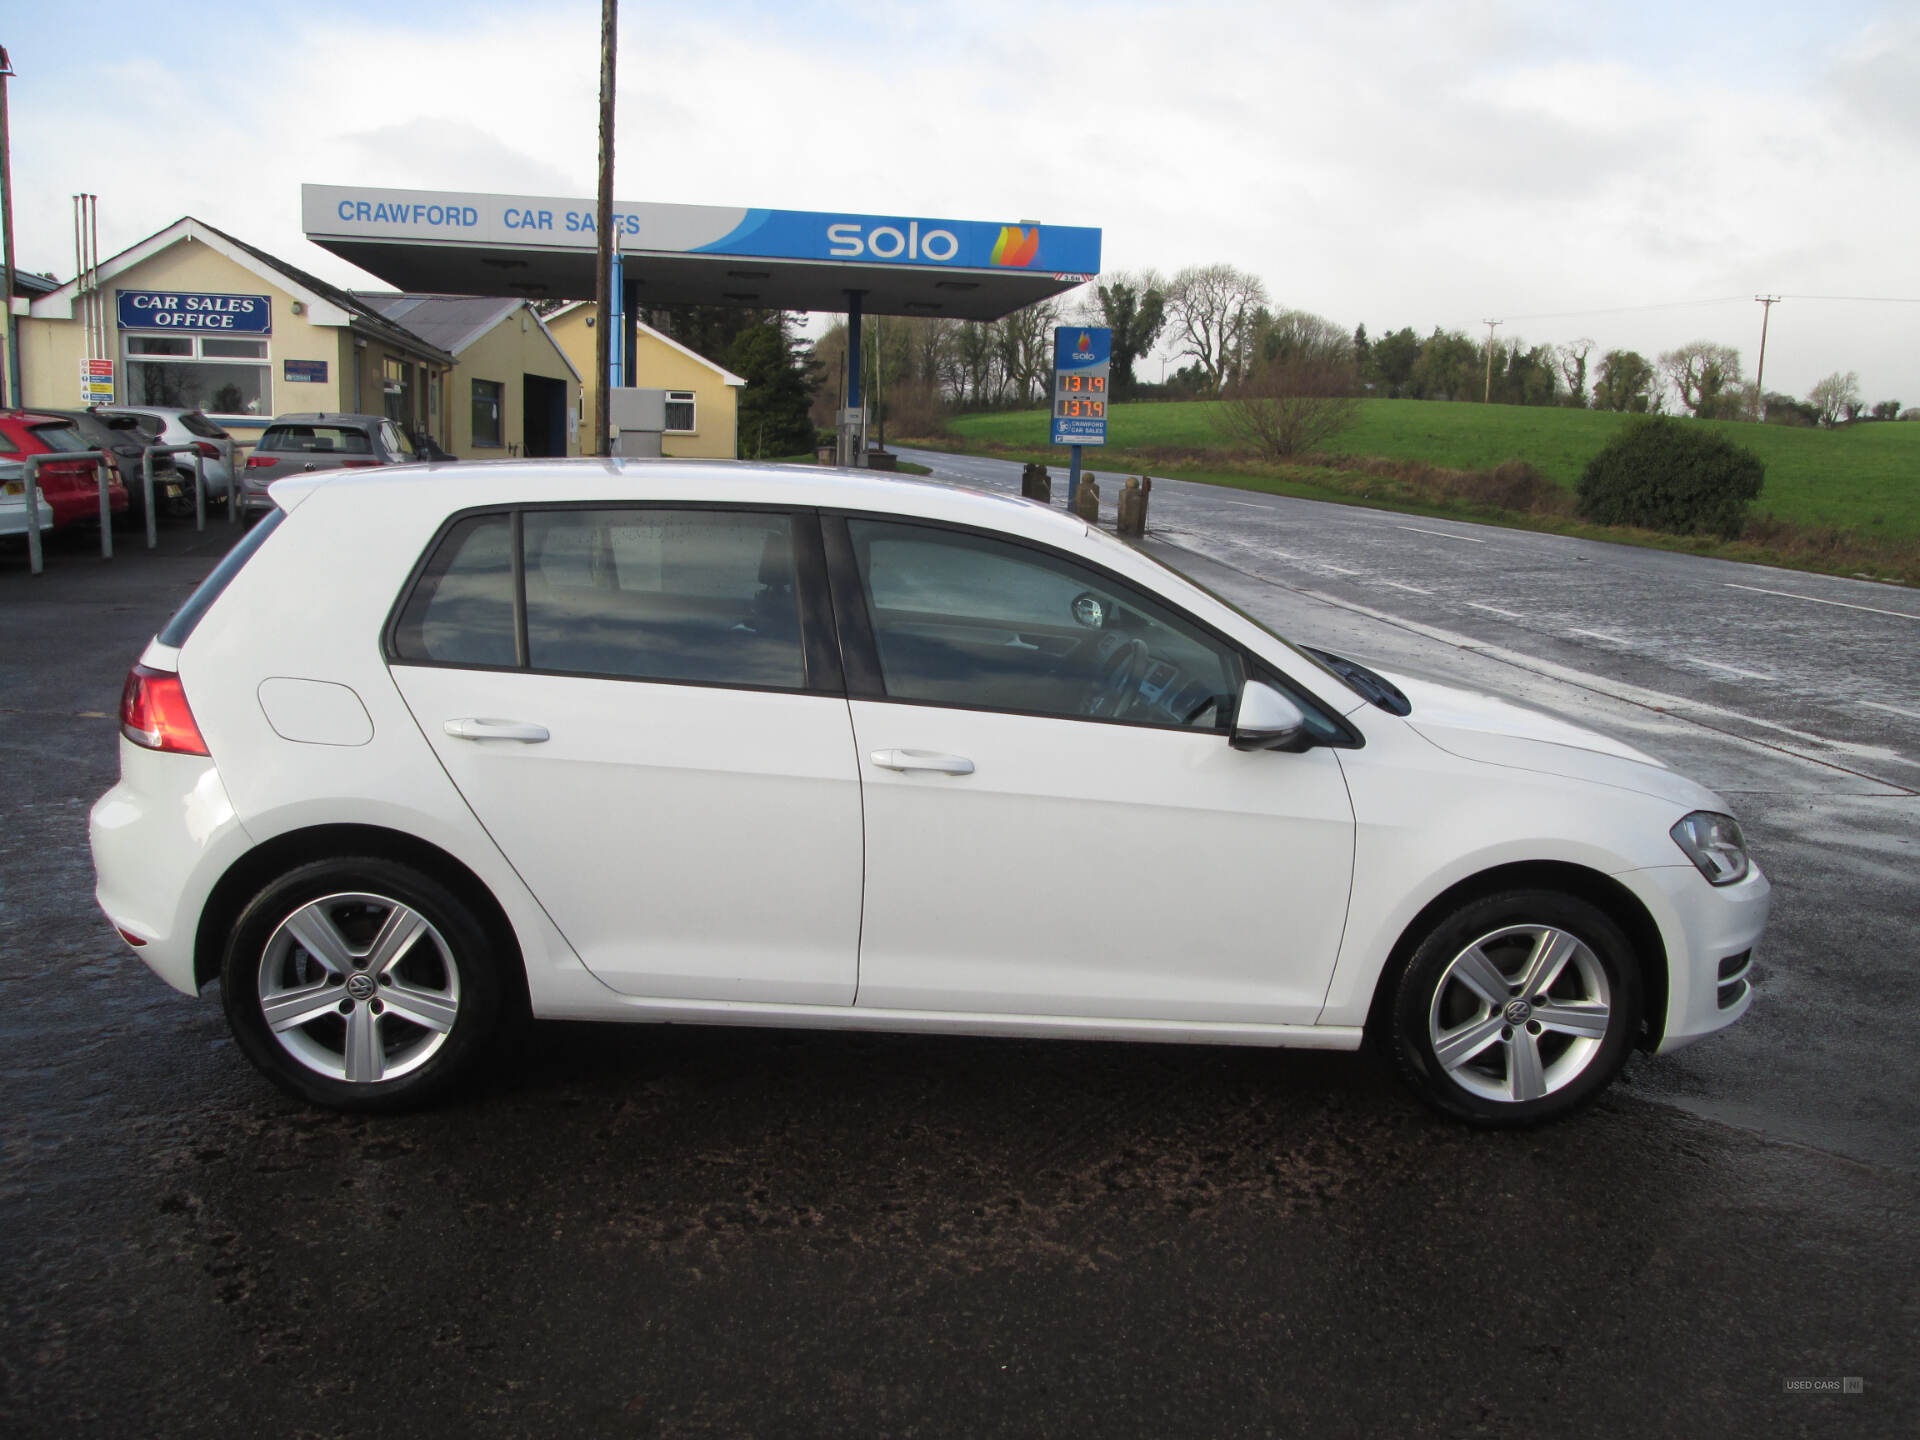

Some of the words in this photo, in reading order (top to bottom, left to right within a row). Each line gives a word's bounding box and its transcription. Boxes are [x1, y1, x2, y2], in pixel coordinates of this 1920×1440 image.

[338, 200, 478, 227] CRAWFORD
[503, 207, 553, 230] CAR
[565, 211, 641, 235] SAES
[826, 221, 960, 261] solo
[133, 295, 179, 310] CAR
[185, 297, 255, 313] SALES
[154, 312, 235, 328] OFFICE
[1064, 375, 1105, 393] 131.9
[1063, 400, 1104, 418] 137.9
